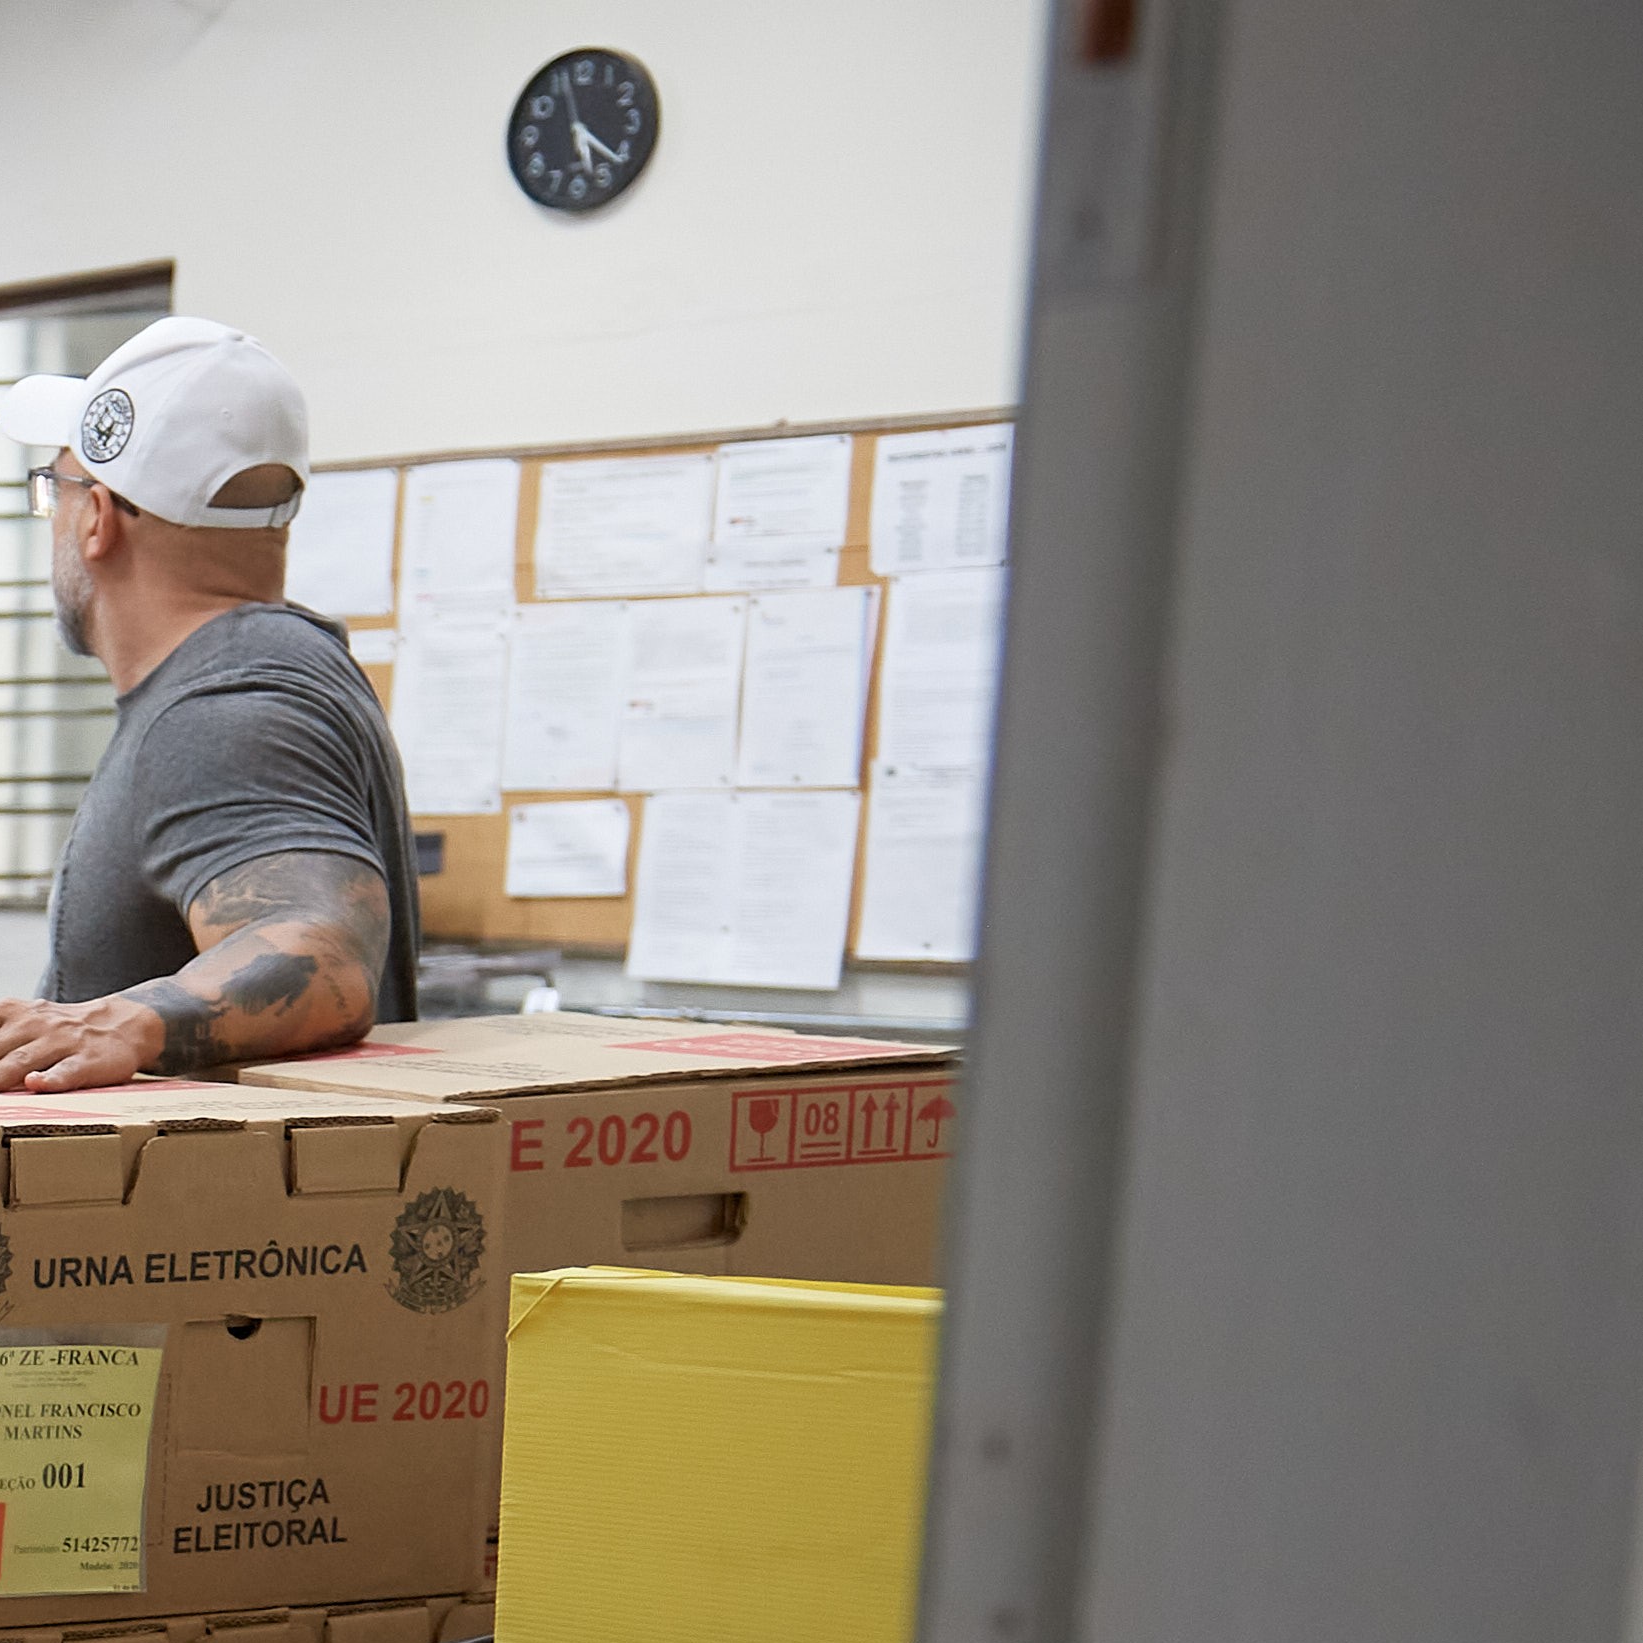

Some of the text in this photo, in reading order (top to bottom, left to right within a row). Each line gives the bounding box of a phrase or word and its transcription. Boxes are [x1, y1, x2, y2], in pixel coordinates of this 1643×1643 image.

[617, 81, 635, 106] 2
[803, 1101, 839, 1137] 08
[564, 1111, 693, 1168] 2020
[33, 1239, 368, 1289] URNA ELETRÔNICA
[19, 1350, 44, 1366] ZE
[40, 1403, 141, 1418] FRANCISCO
[318, 1379, 490, 1424] UE 2020
[4, 1424, 83, 1441] MARTINS
[42, 1462, 86, 1489] 001
[196, 1478, 330, 1513] JUSTIÇA
[62, 1536, 139, 1553] 51425772
[172, 1517, 348, 1554] ELEITORAL
